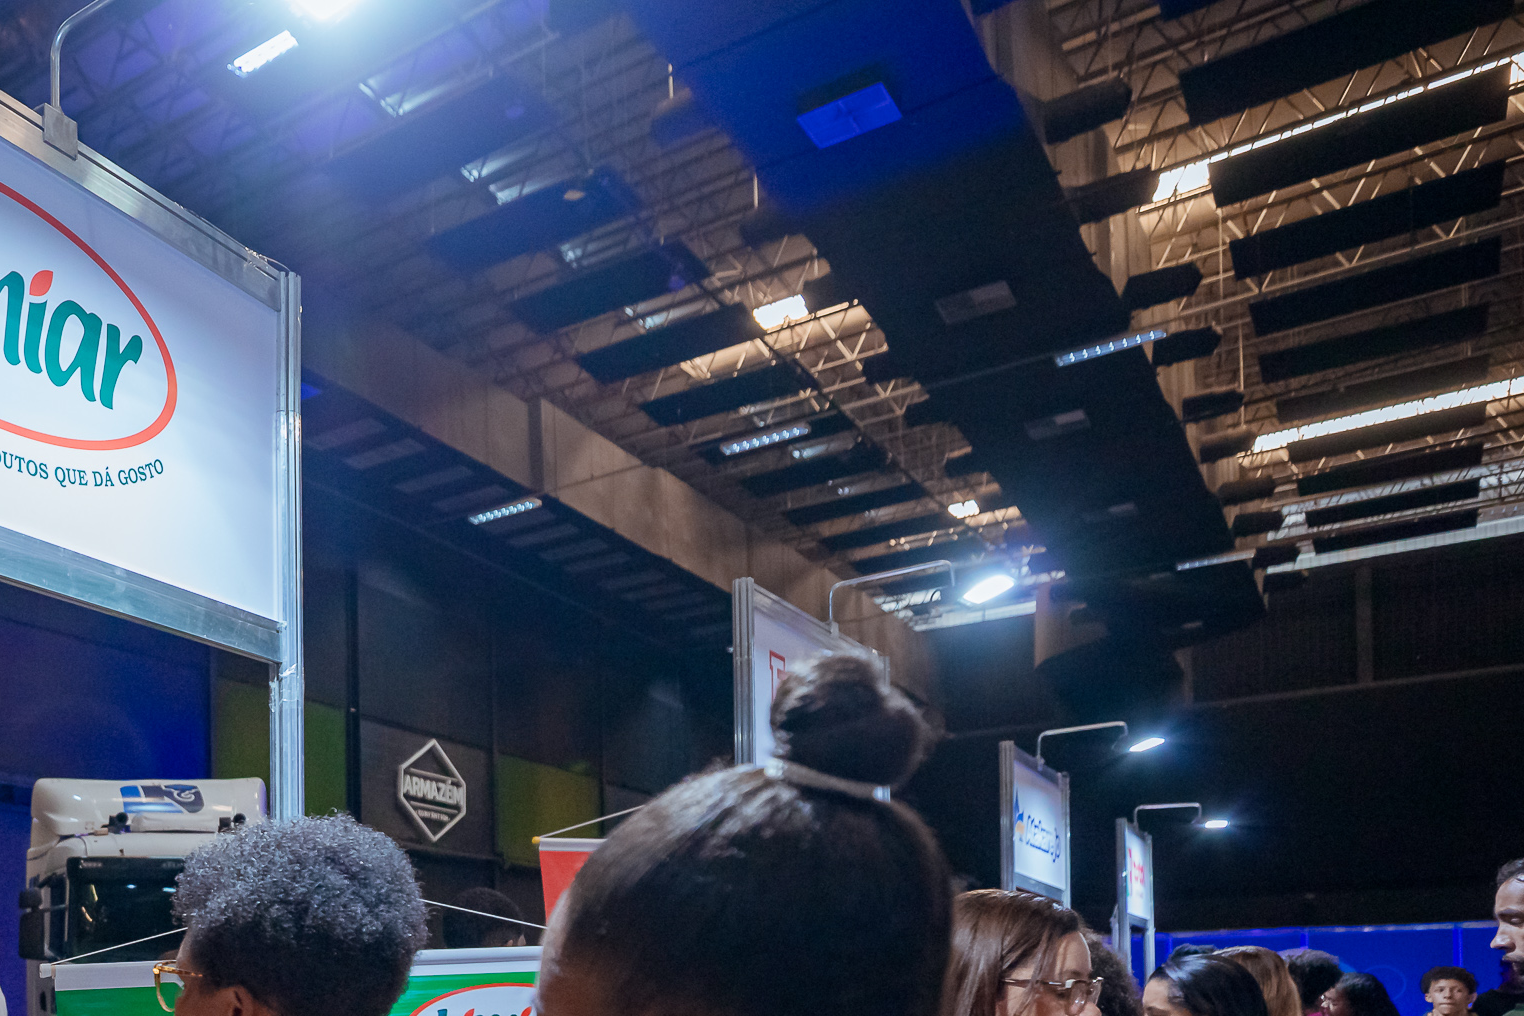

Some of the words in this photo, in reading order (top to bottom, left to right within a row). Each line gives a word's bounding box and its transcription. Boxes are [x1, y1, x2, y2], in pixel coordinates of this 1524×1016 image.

[54, 465, 89, 488] QUE
[92, 465, 115, 487] DÁ
[118, 458, 165, 486] GOSTO
[403, 774, 464, 807] ARMAZÉM
